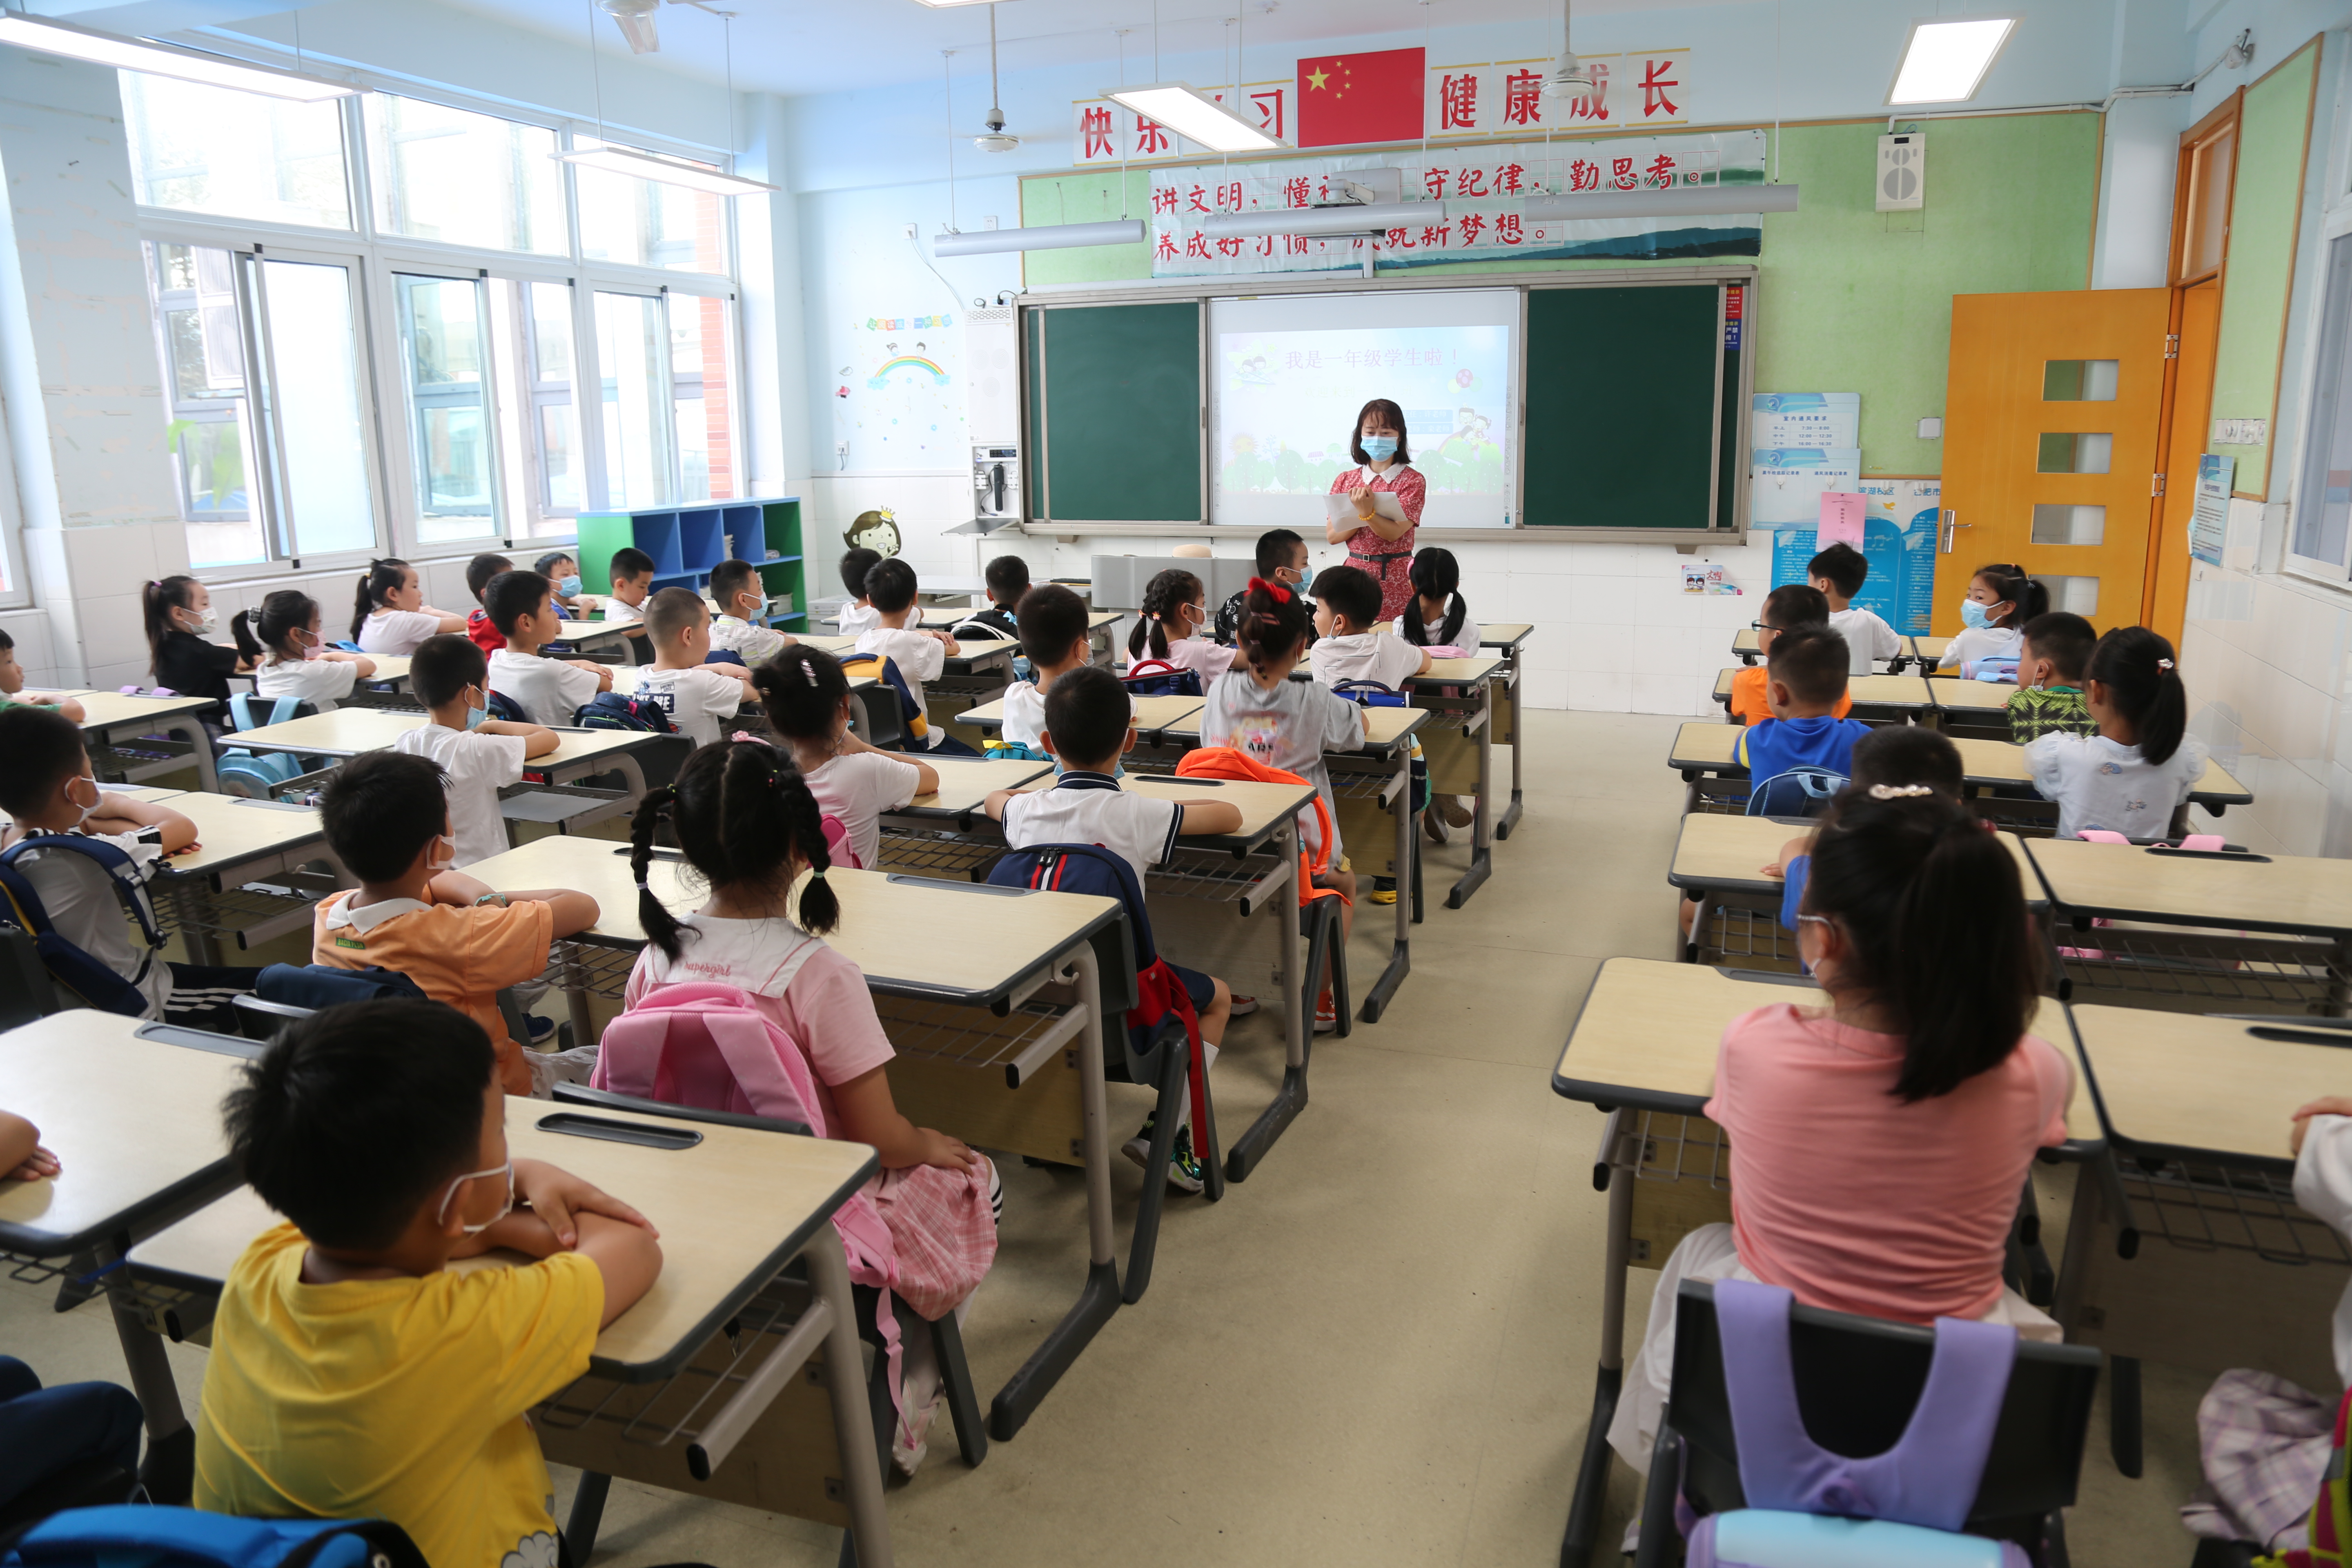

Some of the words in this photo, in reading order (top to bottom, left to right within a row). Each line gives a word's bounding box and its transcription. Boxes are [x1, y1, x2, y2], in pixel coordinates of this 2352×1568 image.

[1080, 89, 1284, 158] 快乐习
[1439, 60, 1679, 130] 健康成长
[1285, 347, 1457, 369] 我是一年级学生啦!
